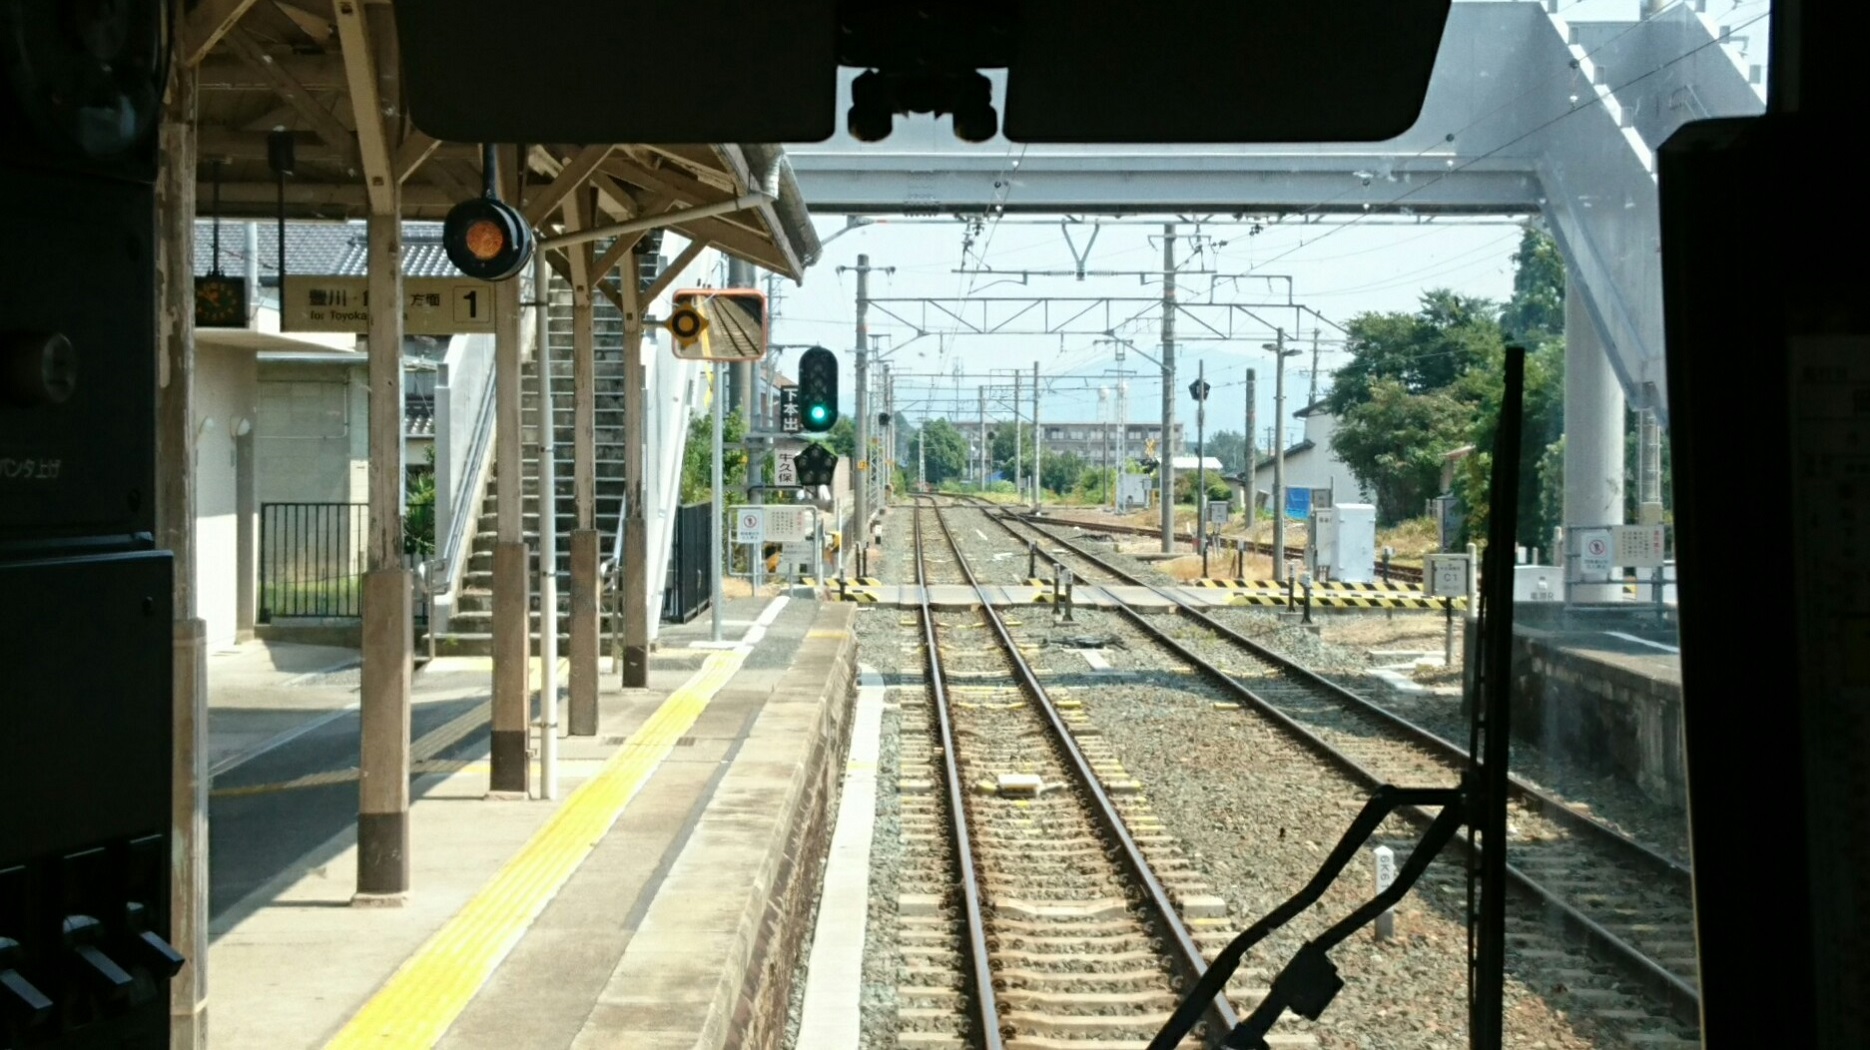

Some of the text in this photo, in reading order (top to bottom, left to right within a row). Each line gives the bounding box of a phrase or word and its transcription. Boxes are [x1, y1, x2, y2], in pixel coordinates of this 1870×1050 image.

[411, 293, 440, 307] 方面
[463, 290, 476, 318] 1
[310, 311, 368, 322] for Toyoka
[783, 387, 799, 432] 下本出
[778, 453, 793, 482] 牛久保
